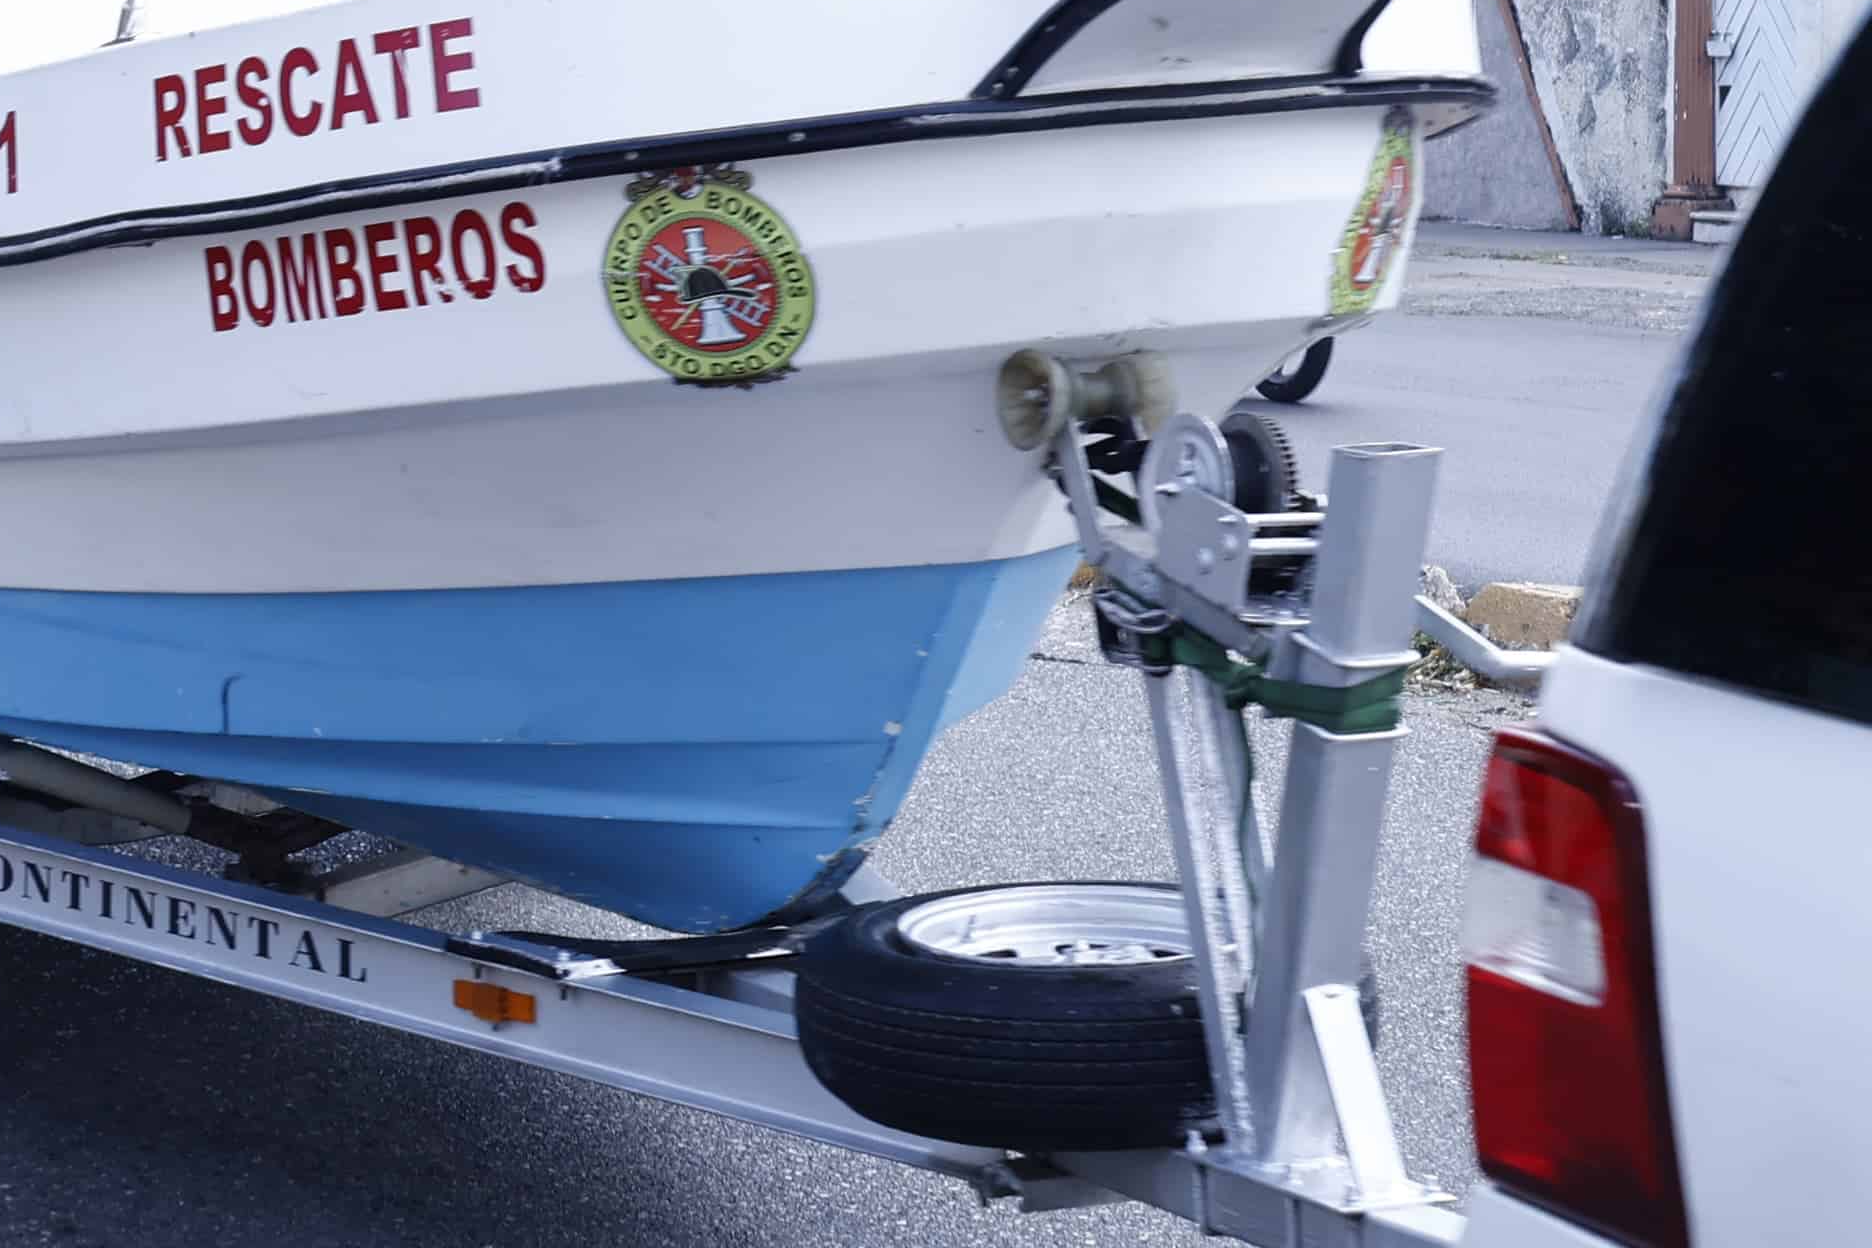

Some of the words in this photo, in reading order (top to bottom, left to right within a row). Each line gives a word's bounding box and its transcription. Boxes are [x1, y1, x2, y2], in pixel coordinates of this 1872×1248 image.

[153, 16, 481, 163] RESCATE
[203, 200, 546, 332] BOMBEROS
[610, 220, 644, 322] CUERPO
[639, 193, 674, 225] DE
[705, 190, 809, 299] BOMBEROS
